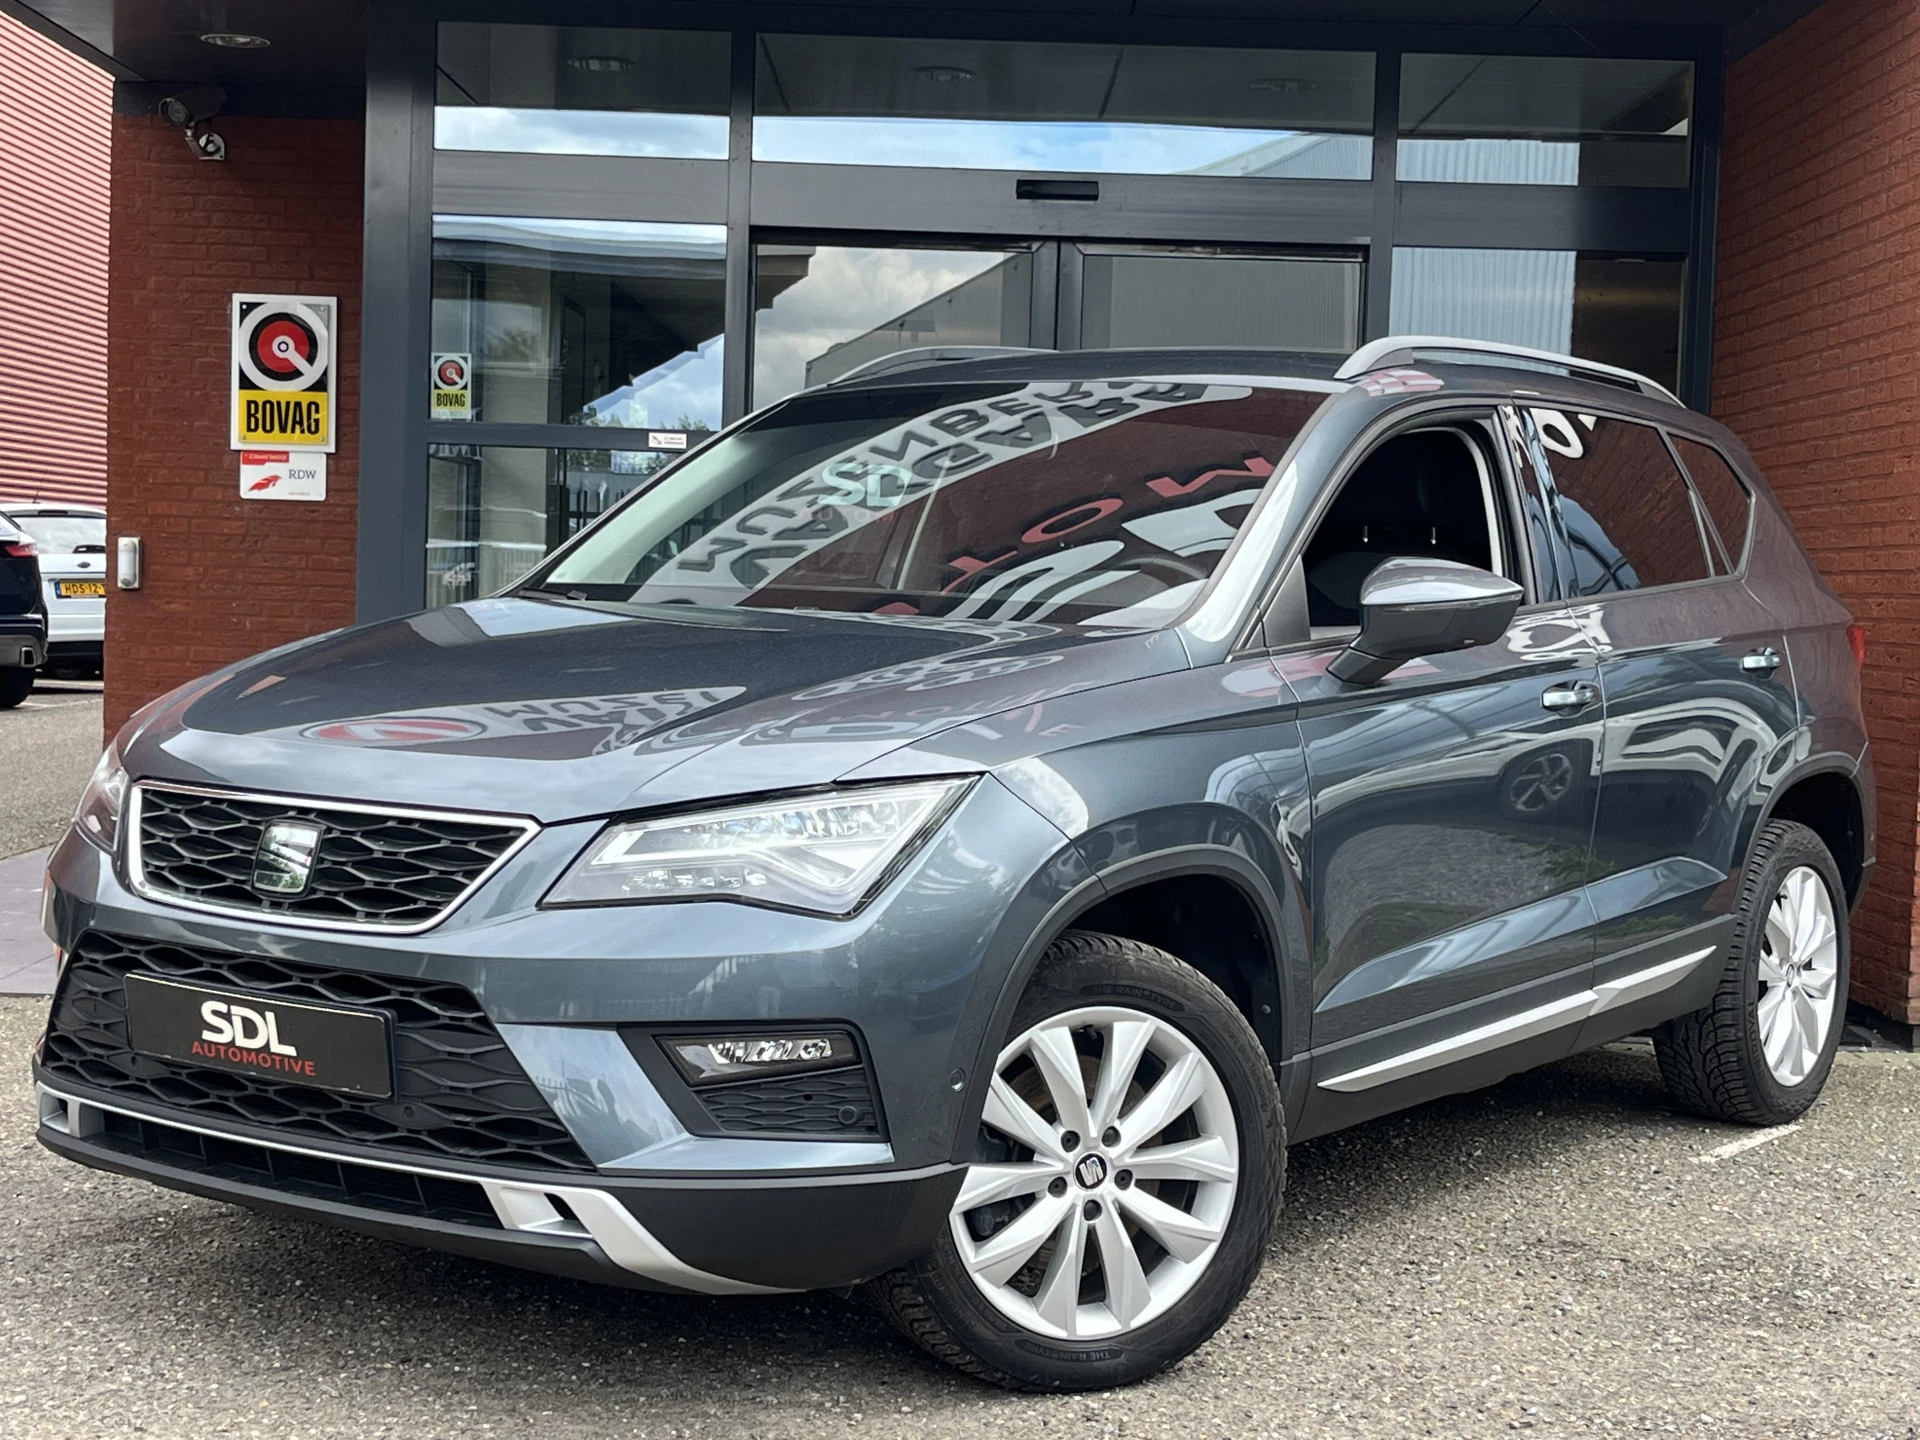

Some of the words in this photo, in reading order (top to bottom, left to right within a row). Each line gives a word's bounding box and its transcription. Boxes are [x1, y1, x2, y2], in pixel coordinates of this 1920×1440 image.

[246, 399, 320, 436] BOVAG
[436, 393, 466, 407] BOVAG
[288, 469, 317, 480] RDW
[200, 1000, 297, 1057] SDL
[191, 1041, 316, 1076] AUTOMOTIVE
